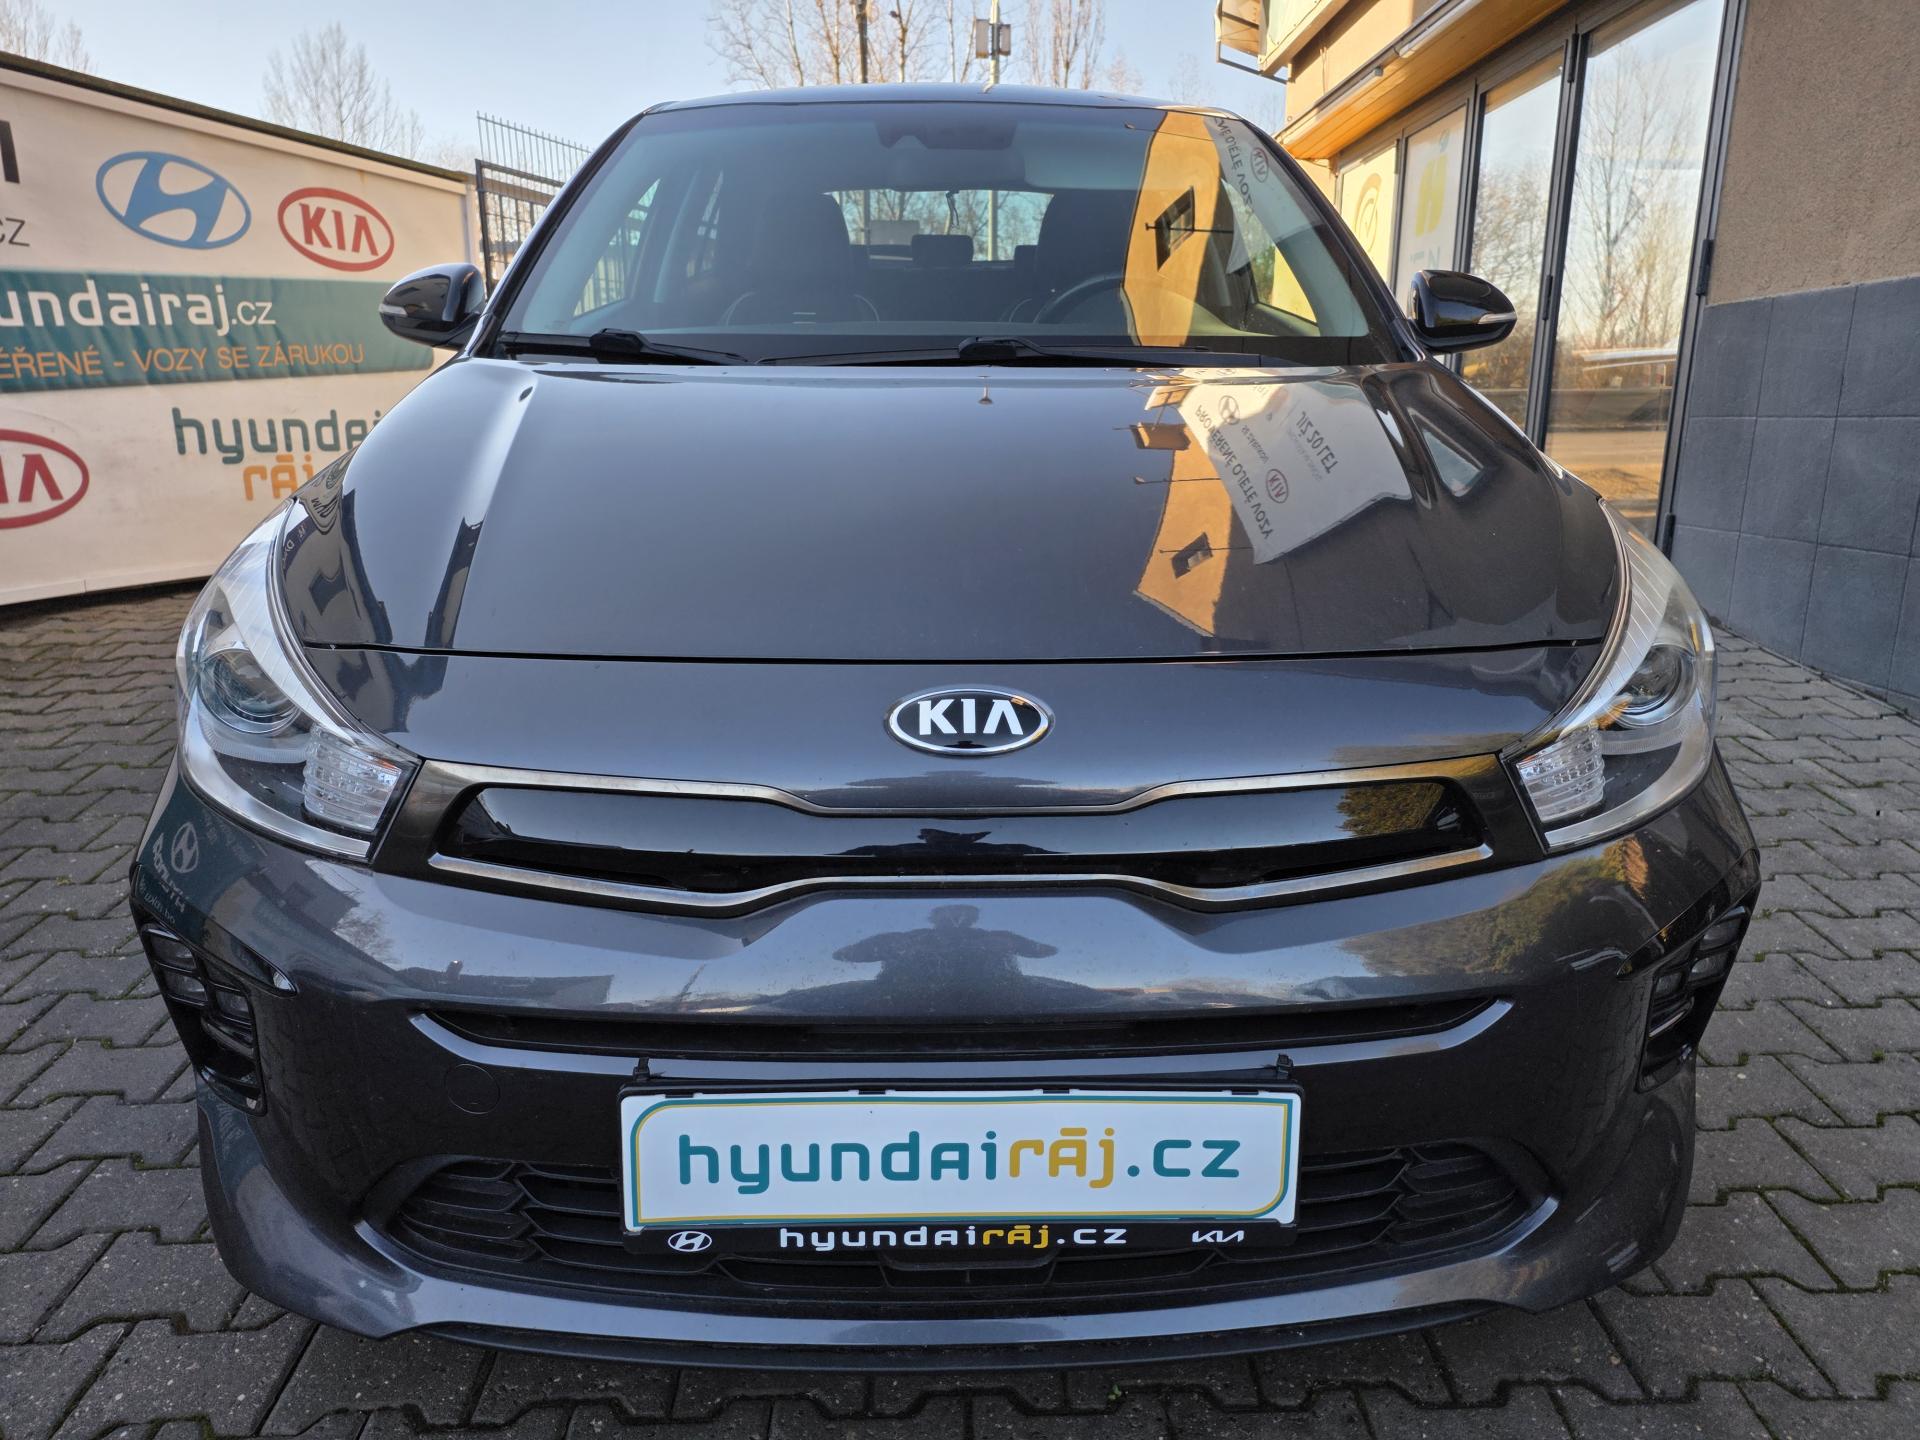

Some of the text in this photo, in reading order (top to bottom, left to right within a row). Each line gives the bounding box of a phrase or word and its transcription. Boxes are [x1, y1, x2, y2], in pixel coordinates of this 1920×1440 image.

[298, 203, 379, 256] KIA
[132, 347, 207, 373] VOZY
[216, 345, 250, 369] SE
[255, 341, 366, 367] ZÁRUKOU
[918, 698, 1024, 736] KIA
